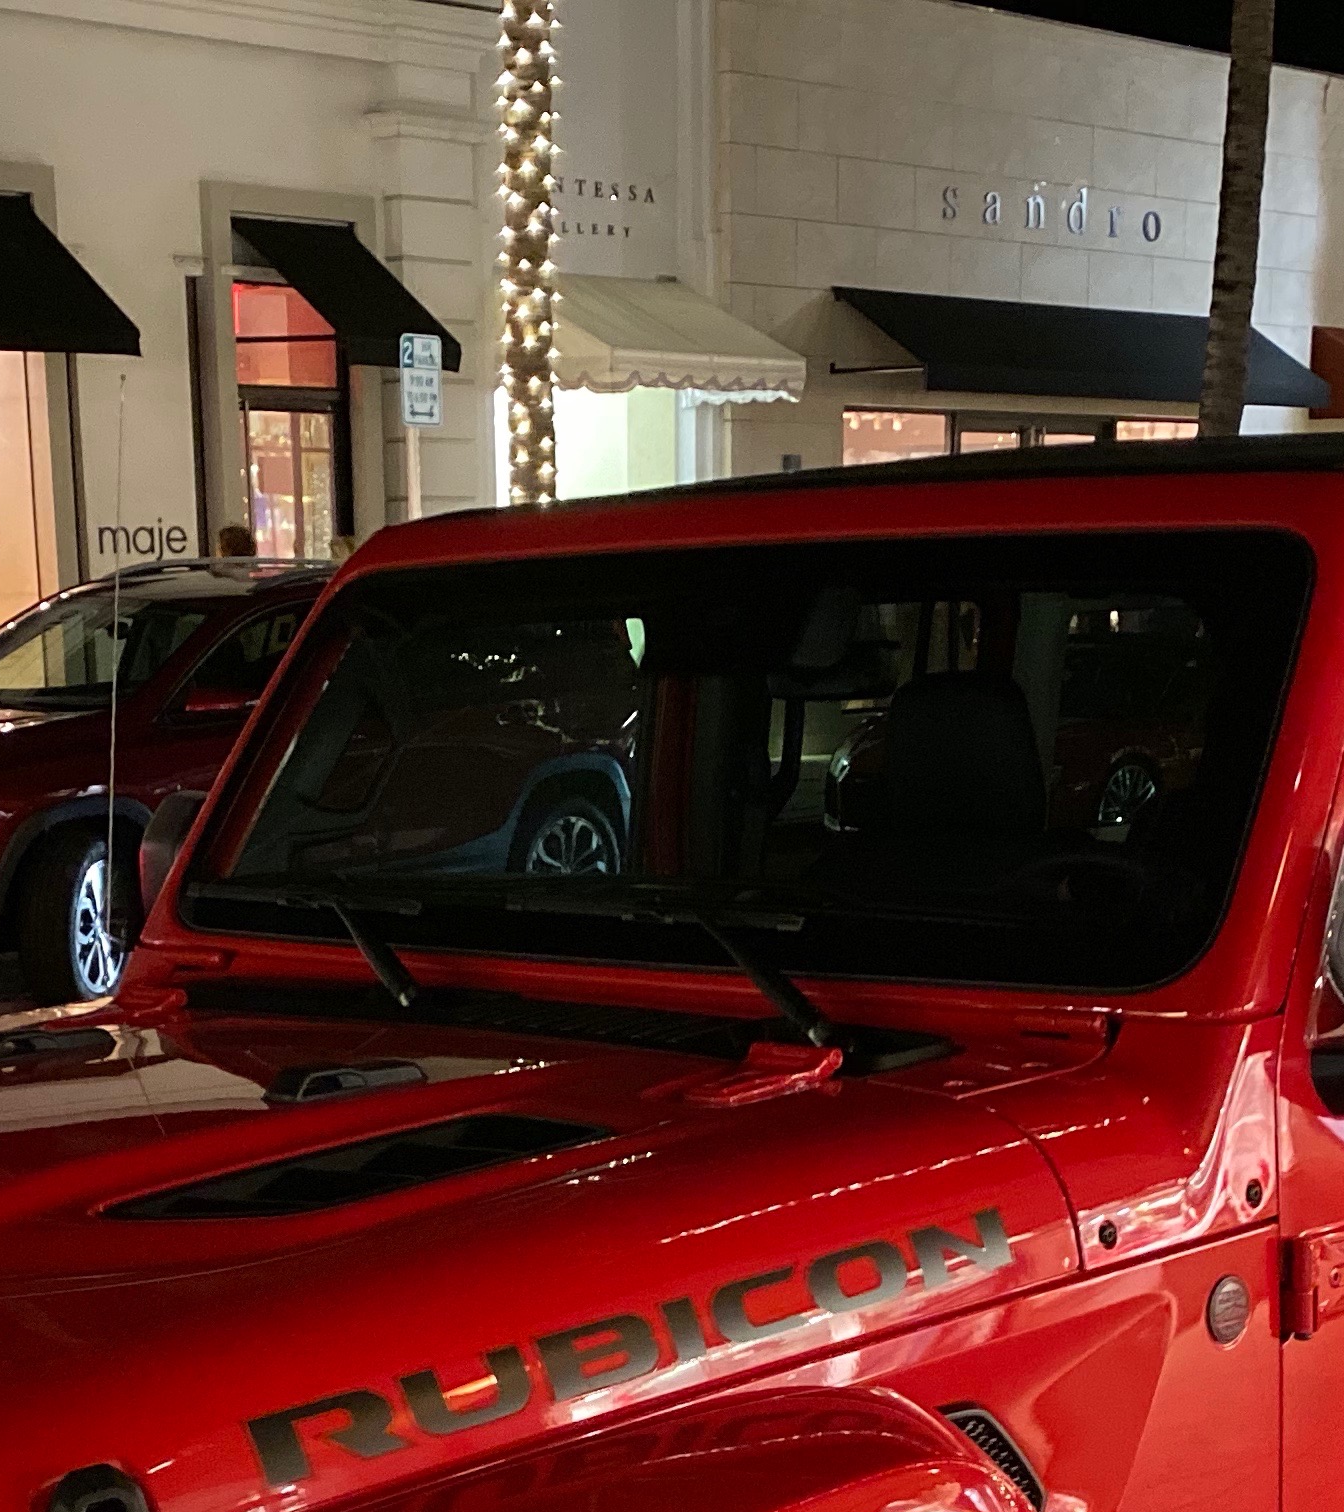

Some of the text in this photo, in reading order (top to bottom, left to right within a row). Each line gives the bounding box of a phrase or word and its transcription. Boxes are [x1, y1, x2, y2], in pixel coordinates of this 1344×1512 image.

[941, 184, 1162, 243] sandro
[403, 341, 413, 364] 2
[98, 517, 187, 561] maje
[247, 1207, 1016, 1487] RUBICON
